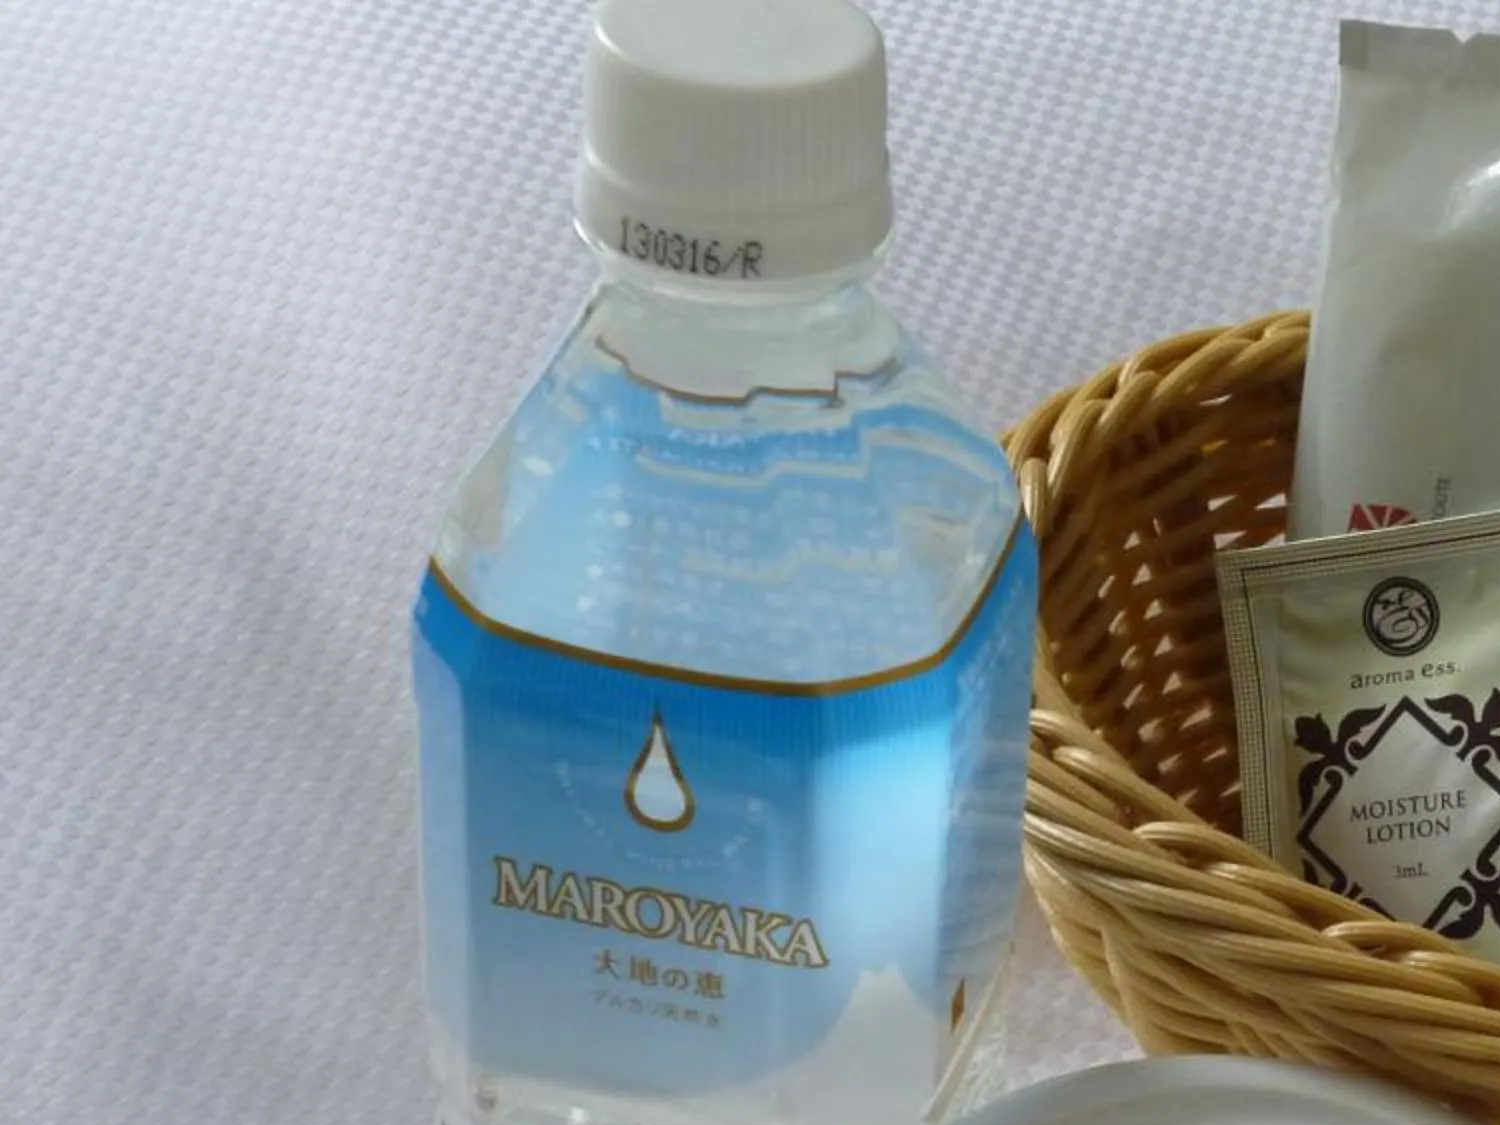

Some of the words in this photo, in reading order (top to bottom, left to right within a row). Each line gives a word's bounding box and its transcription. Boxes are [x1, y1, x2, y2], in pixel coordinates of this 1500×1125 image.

[618, 215, 764, 279] 130316/R
[1350, 669, 1416, 690] aroma
[1420, 660, 1461, 680] ess.
[1350, 788, 1467, 823] MOISTURE
[1366, 816, 1452, 845] LOTION
[494, 856, 830, 969] MAROYAKA
